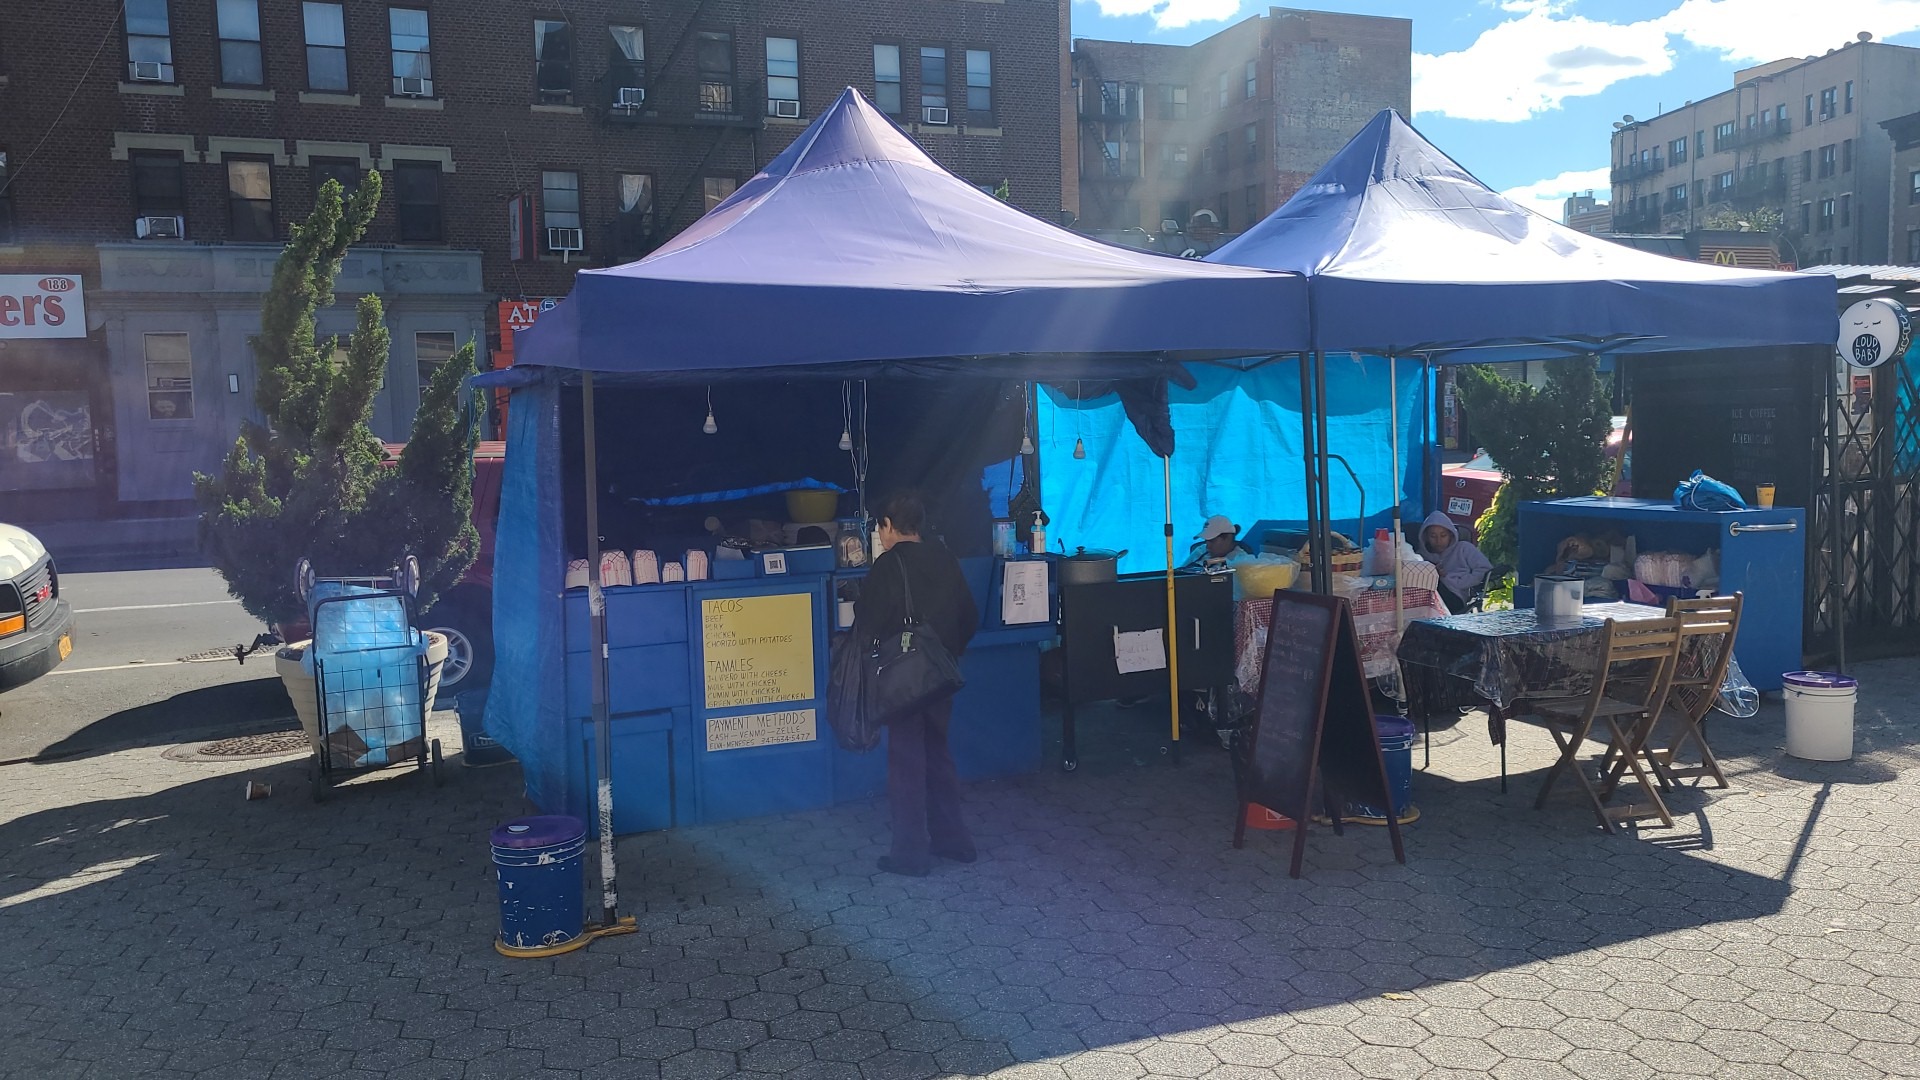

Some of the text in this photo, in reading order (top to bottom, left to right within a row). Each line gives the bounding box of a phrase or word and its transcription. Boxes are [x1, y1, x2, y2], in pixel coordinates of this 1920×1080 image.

[47, 279, 68, 290] 188
[1855, 336, 1878, 348] LOUD
[1855, 347, 1879, 361] BABY
[706, 599, 744, 613] TACOS
[705, 615, 724, 623] BEEF
[705, 631, 736, 639] CHICKEN
[705, 635, 793, 648] CHORIZO WITH POTATOES
[707, 658, 755, 672] TAMALES
[740, 671, 758, 680] WITH
[760, 669, 788, 678] CHEESE
[707, 679, 777, 692] MOLE WITH CHICKEN
[707, 687, 781, 699] CUMIN WITH CHICKEN
[707, 692, 806, 708] GREEN SALSA WITH CHICKEN
[709, 711, 806, 733] PAYMENT METHODS
[709, 732, 729, 742] CASH
[739, 728, 766, 739] VENMO
[776, 726, 801, 735] ZELLE
